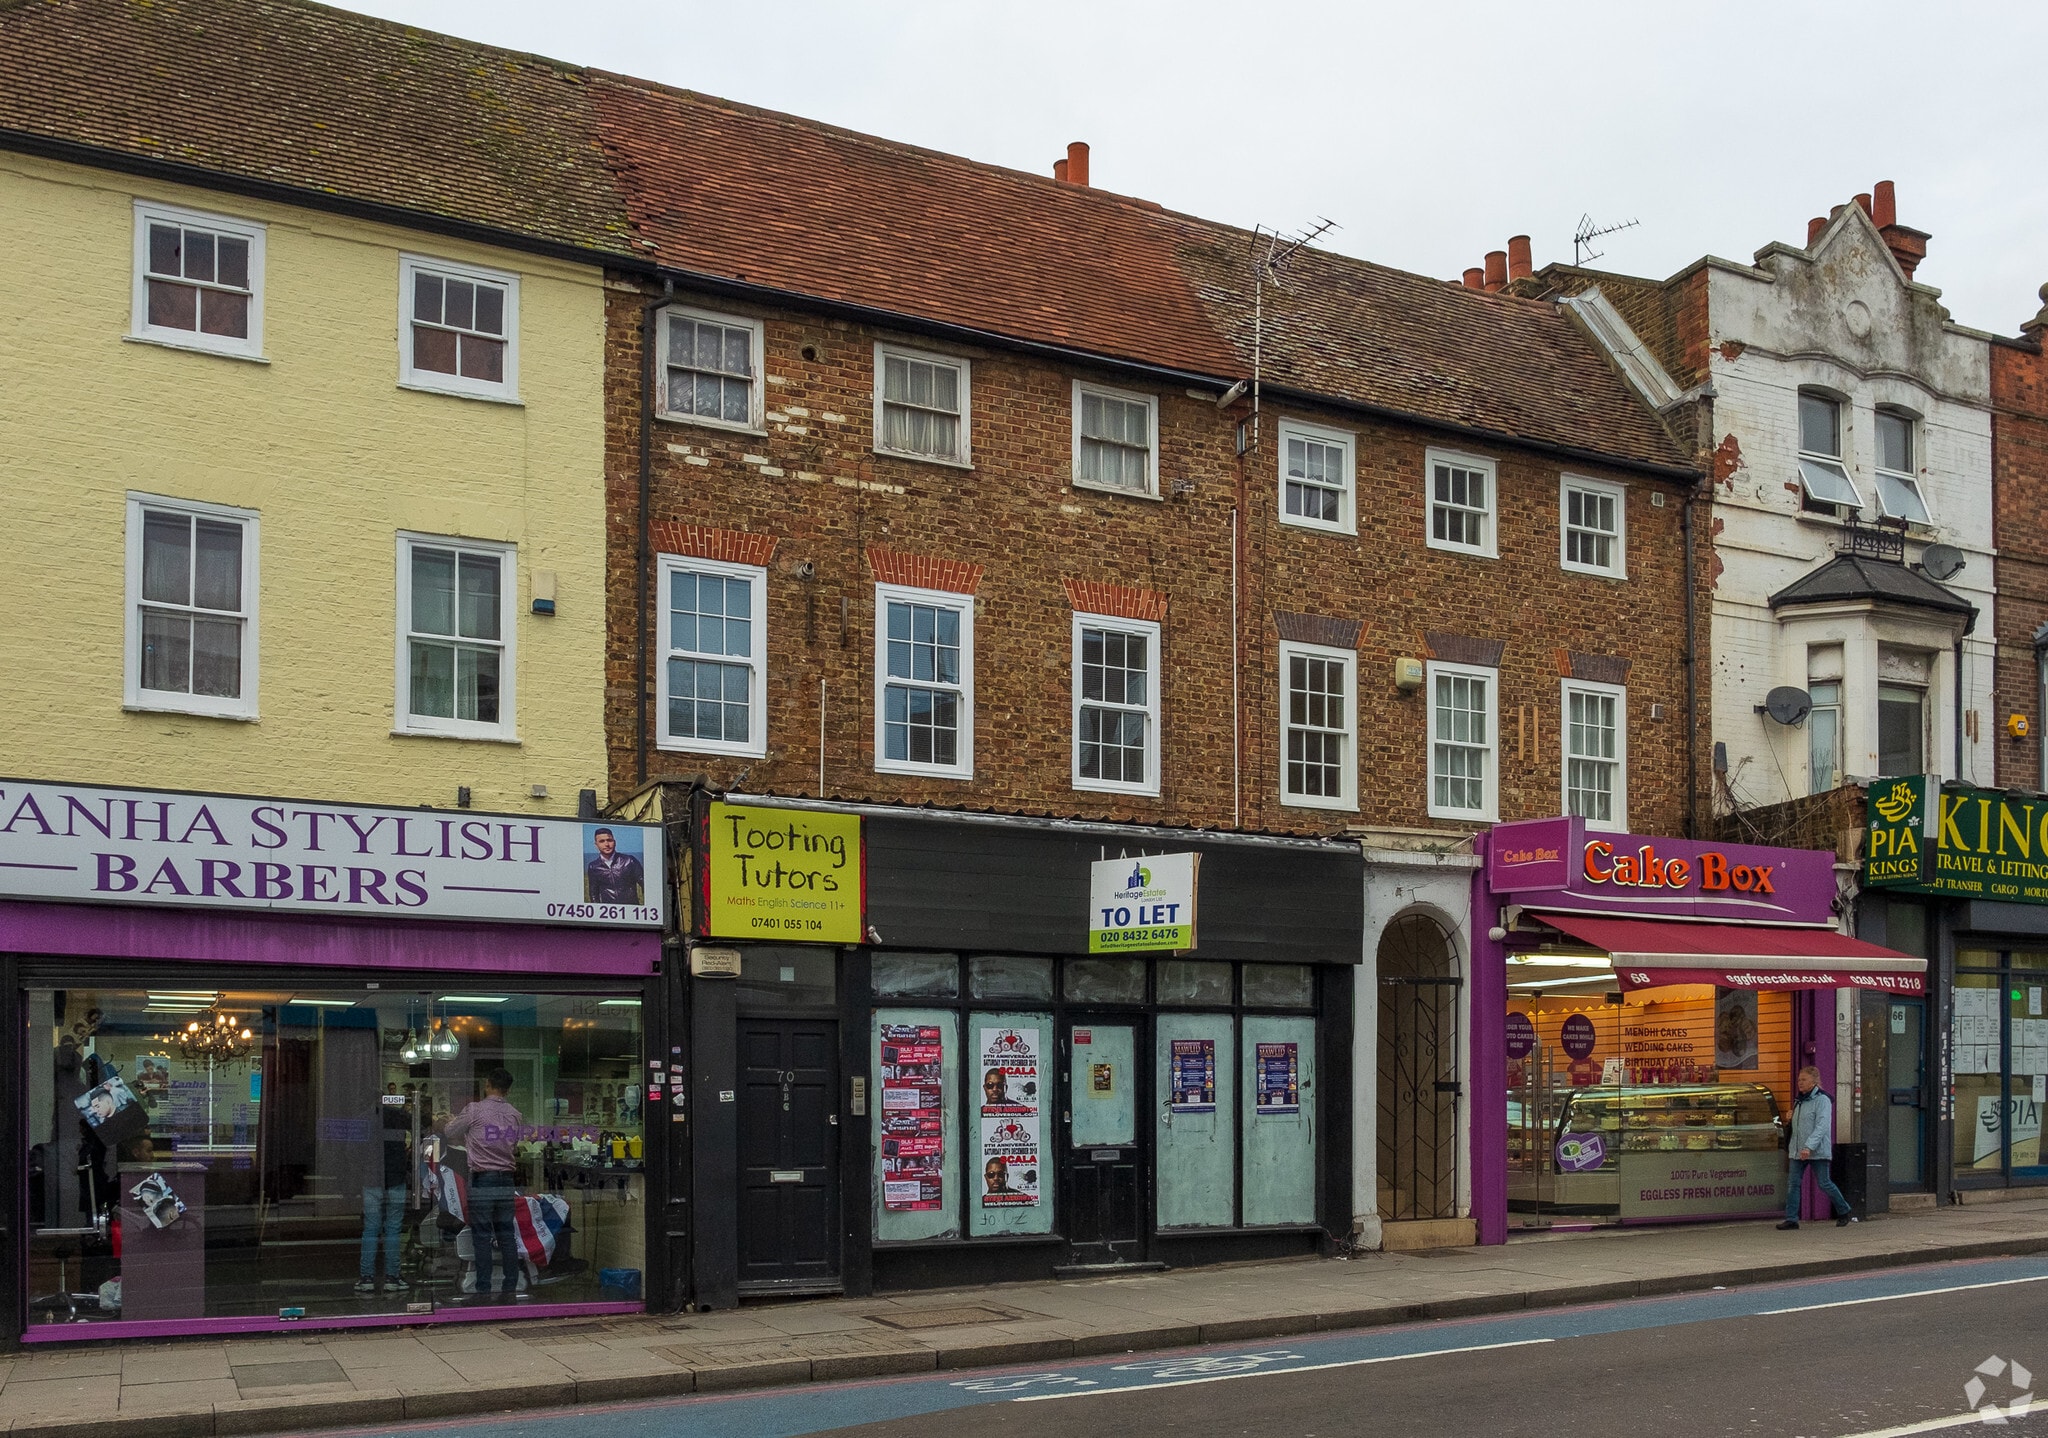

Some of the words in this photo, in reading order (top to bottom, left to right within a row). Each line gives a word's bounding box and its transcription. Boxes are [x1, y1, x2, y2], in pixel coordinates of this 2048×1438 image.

[0, 789, 234, 846] ANHA
[250, 806, 546, 864] STYLISH
[724, 815, 847, 869] Tooting
[1870, 827, 1918, 858] PIA
[1503, 849, 1534, 863] Cake
[1535, 848, 1559, 861] Box
[1937, 853, 1984, 873] TRAVEL
[1986, 859, 1997, 874] &
[733, 853, 839, 892] Tutors
[1583, 840, 1692, 889] Cake
[1698, 852, 1775, 894] Box
[1869, 858, 1918, 875] KINGS
[90, 852, 429, 907] BARBERS
[1946, 879, 1983, 892] TRANSFER
[1991, 883, 2019, 895] CARGO
[726, 896, 756, 907] Maths
[757, 897, 789, 909] English
[790, 899, 827, 910] Science
[829, 900, 845, 910] 11+
[546, 903, 595, 918] 07450
[599, 905, 627, 919] 261
[632, 907, 659, 921] 113
[1101, 907, 1131, 927] TO
[1139, 904, 1180, 925] LET
[751, 917, 781, 929] 07401
[784, 919, 802, 929] 055
[805, 920, 822, 930] 104
[1101, 932, 1120, 942] 020
[1123, 930, 1149, 941] 8432
[1152, 928, 1178, 940] 6476
[1629, 972, 1650, 984] 68
[1726, 973, 1836, 986] eggfreecake.co.uk
[1850, 975, 1877, 985] 0208
[1876, 976, 1896, 988] 767
[1898, 977, 1921, 990] 2318
[1892, 1011, 1903, 1021] 66
[1624, 1027, 1659, 1037] MENDHI
[1660, 1027, 1688, 1037] CAKES
[1624, 1043, 1665, 1052] WEDDING
[1666, 1043, 1694, 1052] CAKES
[1624, 1057, 1666, 1067] BIRTHDAY
[1668, 1057, 1695, 1067] CAKES
[777, 1070, 795, 1082] 70
[998, 1066, 1037, 1076] SCALA
[999, 1155, 1038, 1164] SCALA
[1670, 1170, 1690, 1180] 100%
[1691, 1170, 1708, 1180] Pure
[1709, 1169, 1748, 1181] Vegetarian
[1640, 1188, 1680, 1201] EGGLESS
[1682, 1187, 1711, 1199] FRESH
[1714, 1185, 1745, 1198] CREAM
[1746, 1184, 1775, 1196] CAKES
